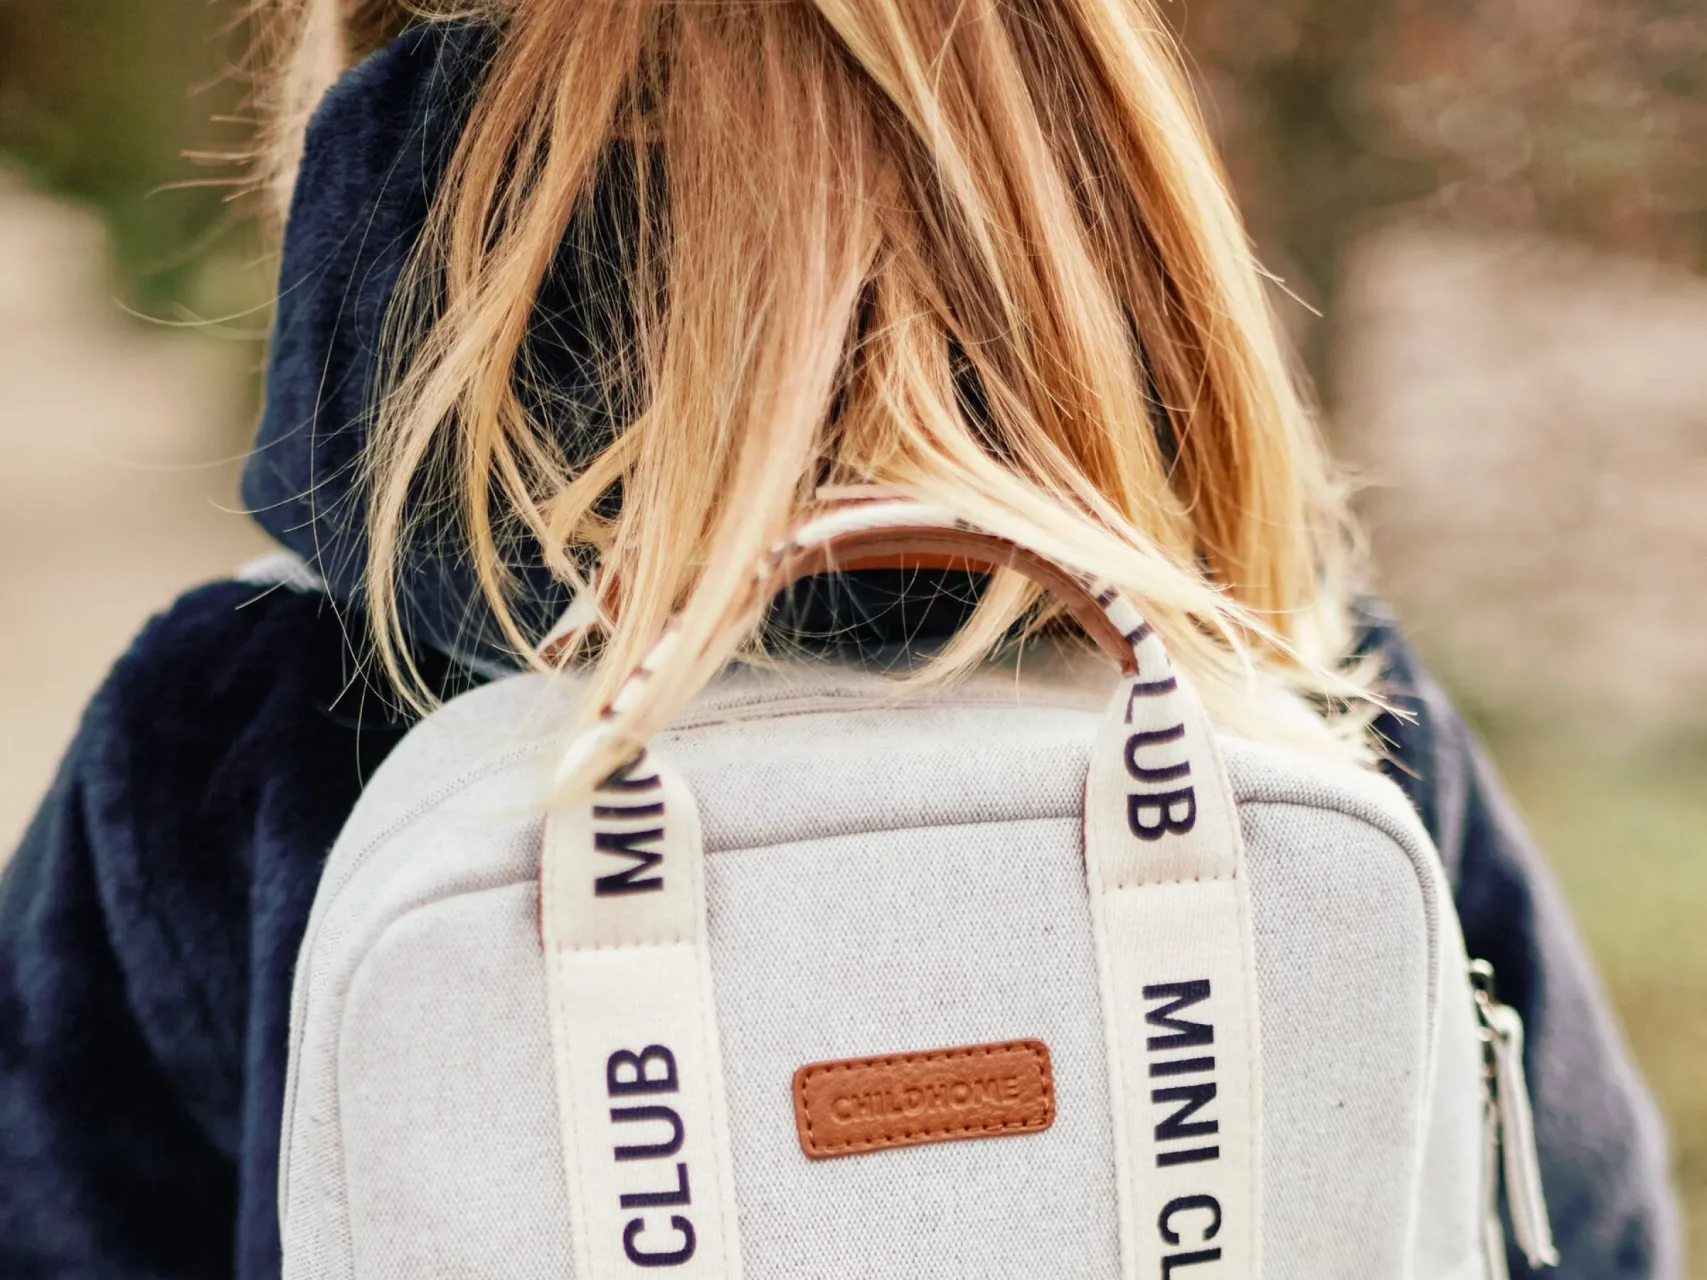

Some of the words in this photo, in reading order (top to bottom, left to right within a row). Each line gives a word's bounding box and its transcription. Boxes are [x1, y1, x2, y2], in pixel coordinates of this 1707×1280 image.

[593, 746, 665, 897] MIN
[605, 1043, 697, 1268] CLUB
[830, 1075, 1020, 1124] CHILDHOME
[1142, 978, 1221, 1169] MINI
